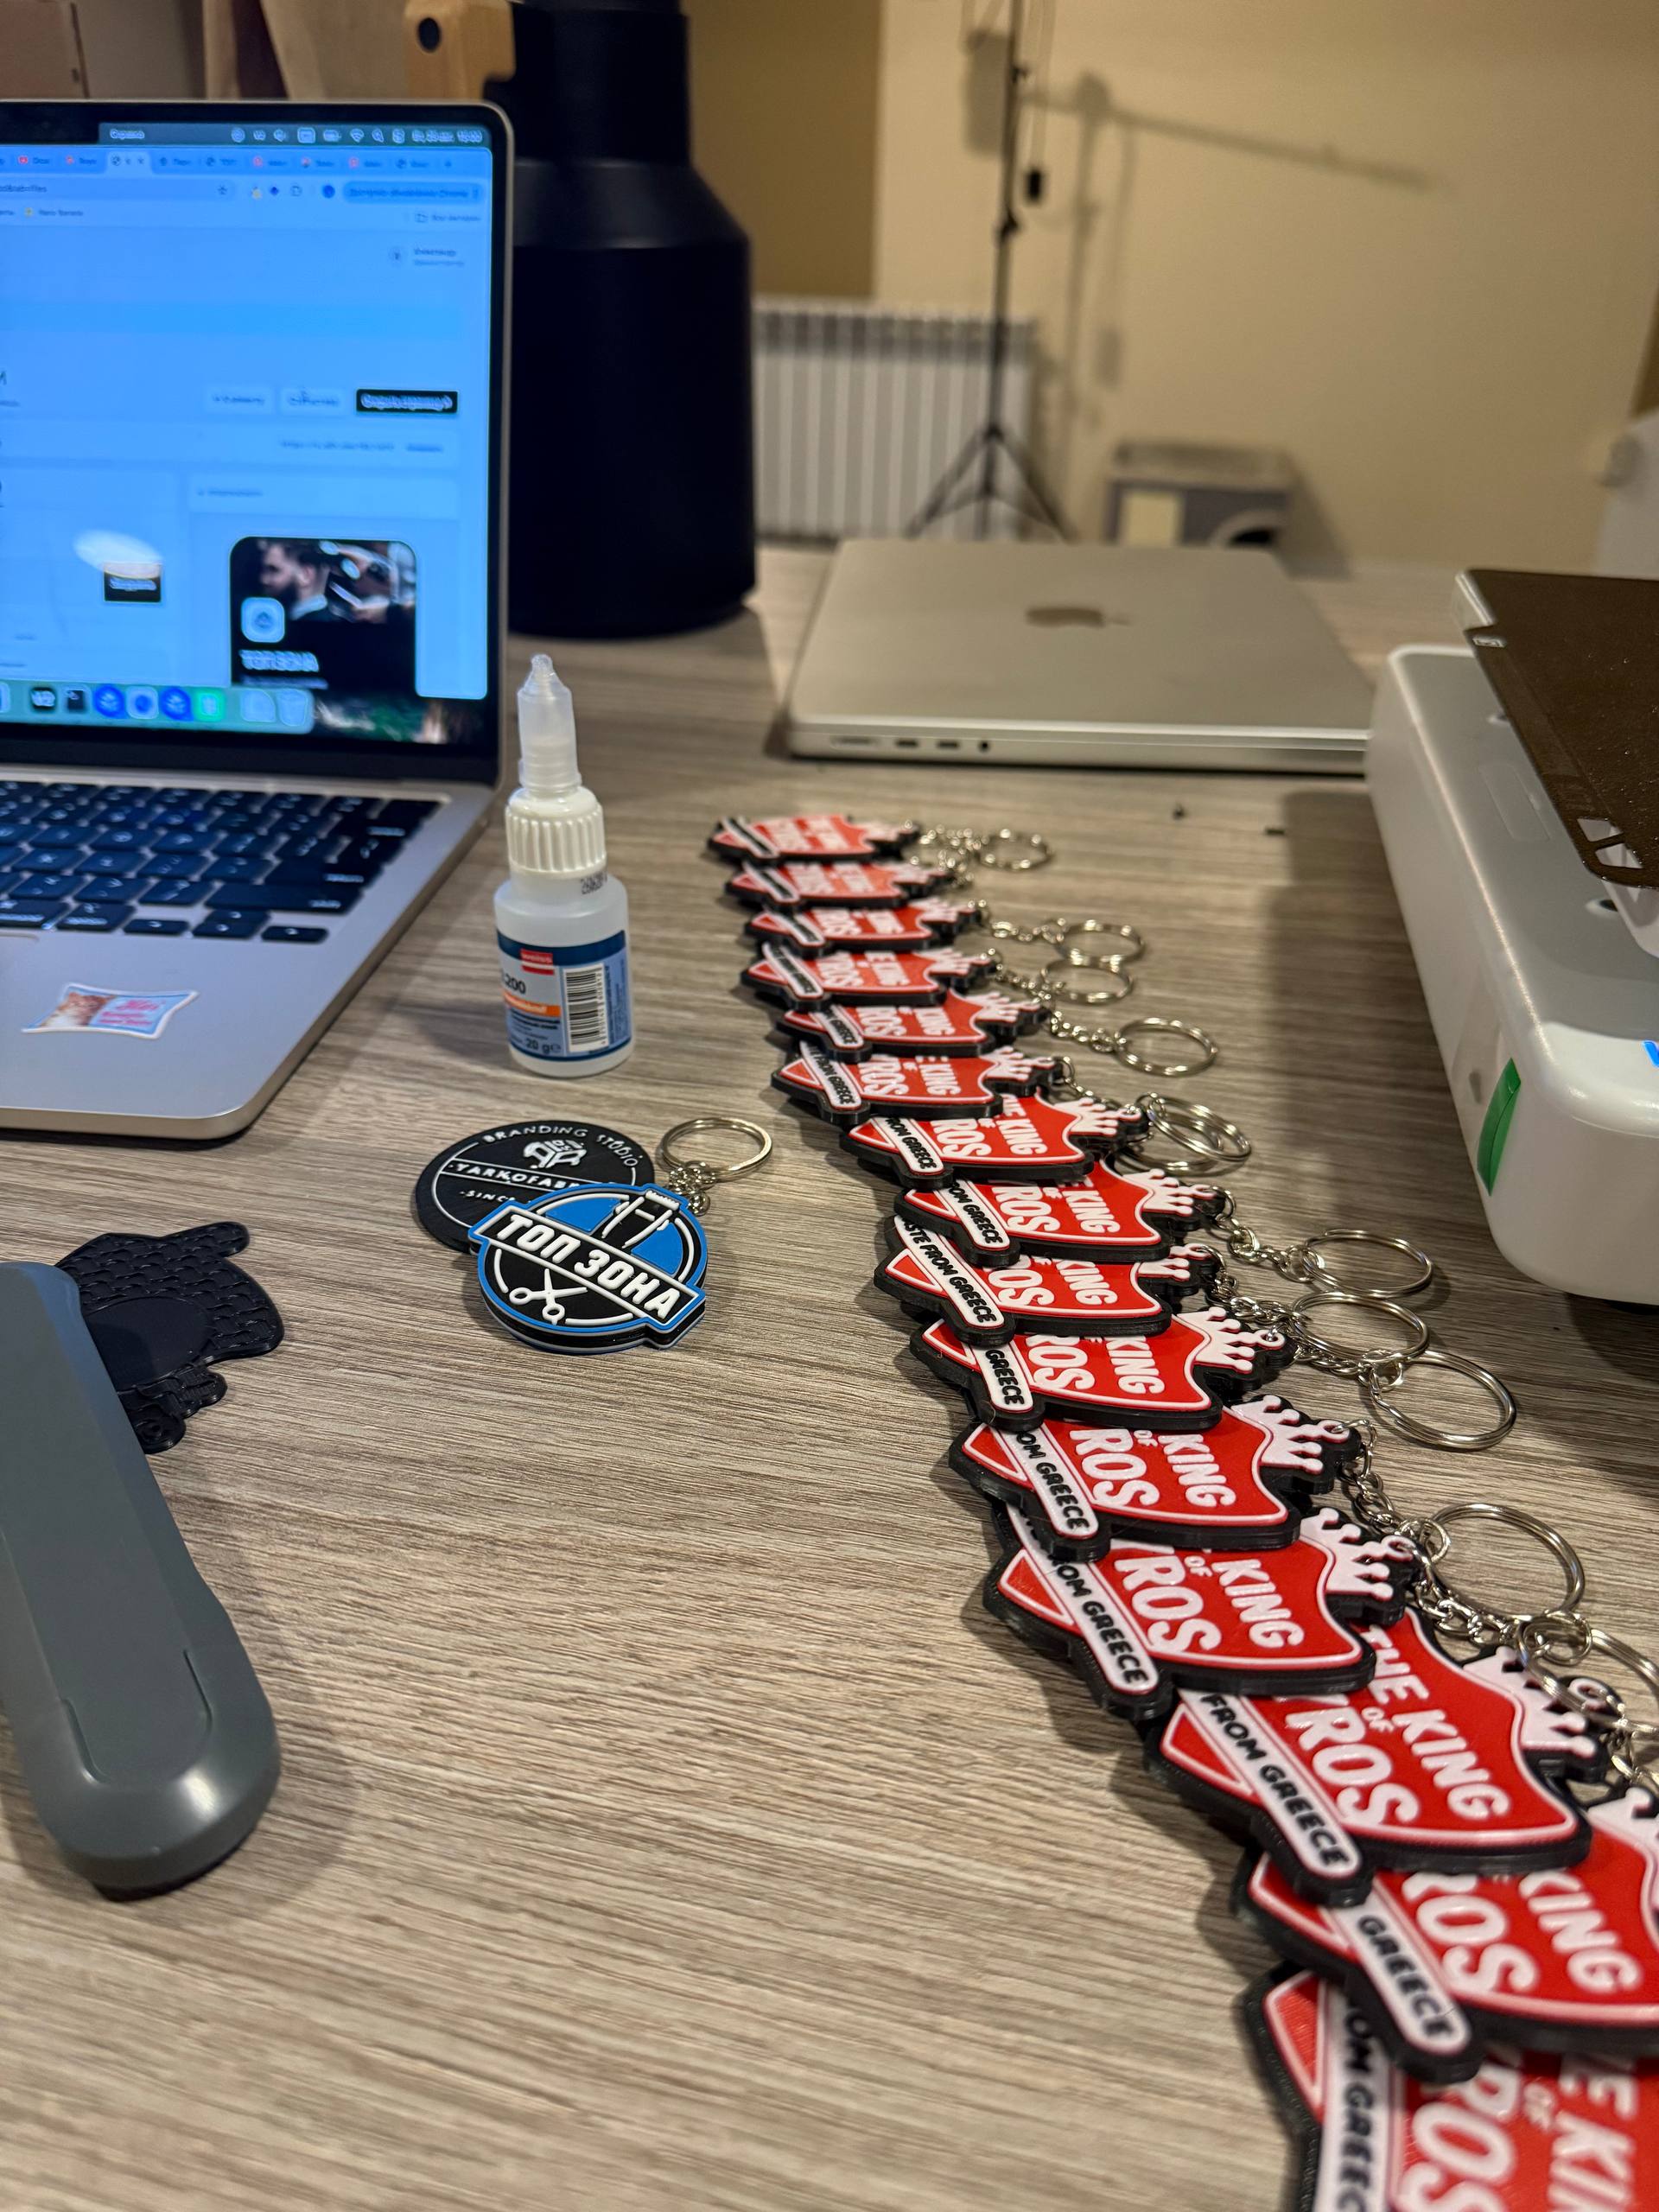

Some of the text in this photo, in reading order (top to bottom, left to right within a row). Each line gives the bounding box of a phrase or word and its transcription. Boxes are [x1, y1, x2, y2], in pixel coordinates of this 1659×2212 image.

[855, 1007, 907, 1036] ROS
[858, 1056, 909, 1096] ROS
[481, 1125, 588, 1143] BRANDING
[902, 1136, 937, 1169] GREECE
[930, 1119, 993, 1157] ROS
[995, 1119, 1048, 1155] KING
[949, 1181, 1003, 1244] OM GREECE
[991, 1186, 1061, 1232] ROS
[1062, 1190, 1122, 1234] KING
[497, 1214, 681, 1319] ТОП ЗОНА
[919, 1244, 958, 1275] FROM
[949, 1276, 997, 1324] GREECE
[1052, 1259, 1118, 1306] KING
[985, 1350, 1025, 1406] GREECE
[1025, 1335, 1096, 1390] ROS
[1103, 1336, 1166, 1395] KING
[1069, 1428, 1160, 1506] ROS
[1134, 1429, 1159, 1447] OF
[1016, 1431, 1090, 1530] OM GREECE
[1157, 1433, 1236, 1507] KING
[1185, 1555, 1212, 1578] OF
[1052, 1560, 1149, 1684] OM GREECE
[1211, 1559, 1305, 1649] KING
[1361, 1706, 1395, 1733] OF
[1199, 1694, 1353, 1866] FROM GREECE
[1391, 1709, 1510, 1821] KING
[1402, 1872, 1540, 1993] OS
[1357, 1915, 1455, 2037] GREECE
[1338, 2082, 1375, 2212] GREEC
[1400, 2061, 1523, 2212] ROS
[1547, 2109, 1637, 2212] KI
